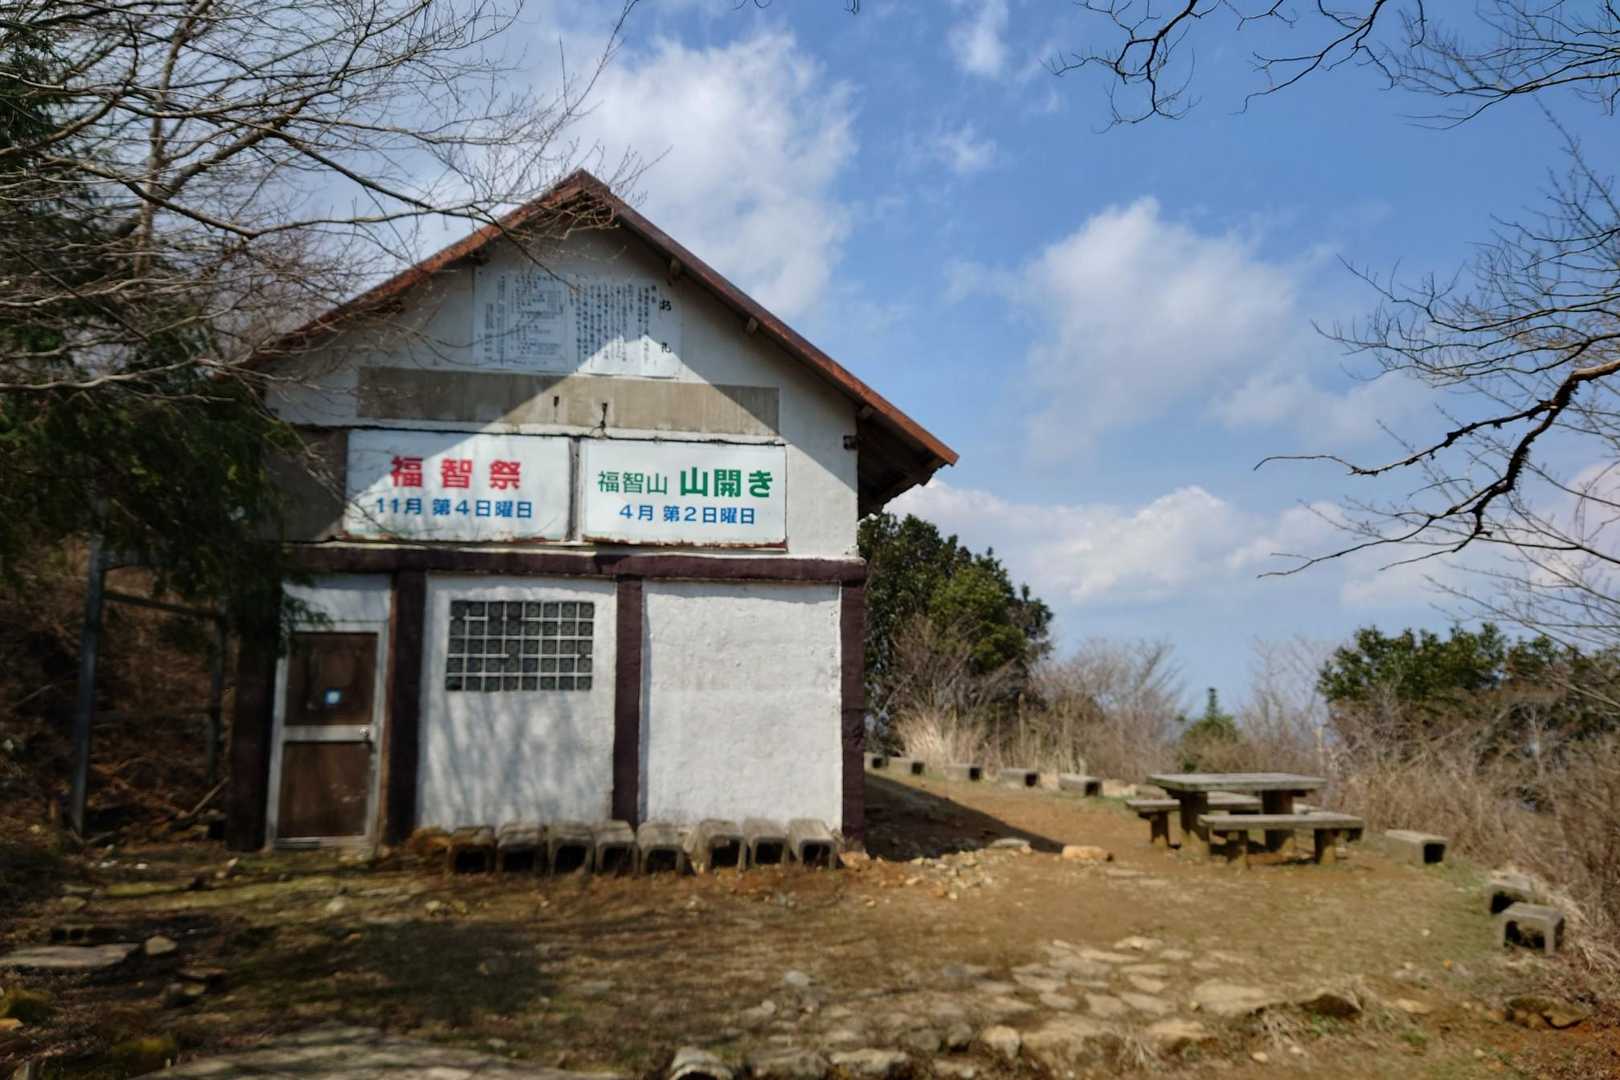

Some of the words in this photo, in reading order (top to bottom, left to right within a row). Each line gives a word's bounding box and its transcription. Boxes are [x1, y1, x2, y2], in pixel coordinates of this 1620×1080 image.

[390, 456, 521, 490] 福智祭
[598, 470, 669, 496] 福智山
[679, 466, 774, 499] 山開き
[376, 497, 423, 517] 11月
[432, 498, 533, 520] 第4日曜日
[619, 504, 653, 522] 4月
[663, 504, 756, 526] 第2日曜日
